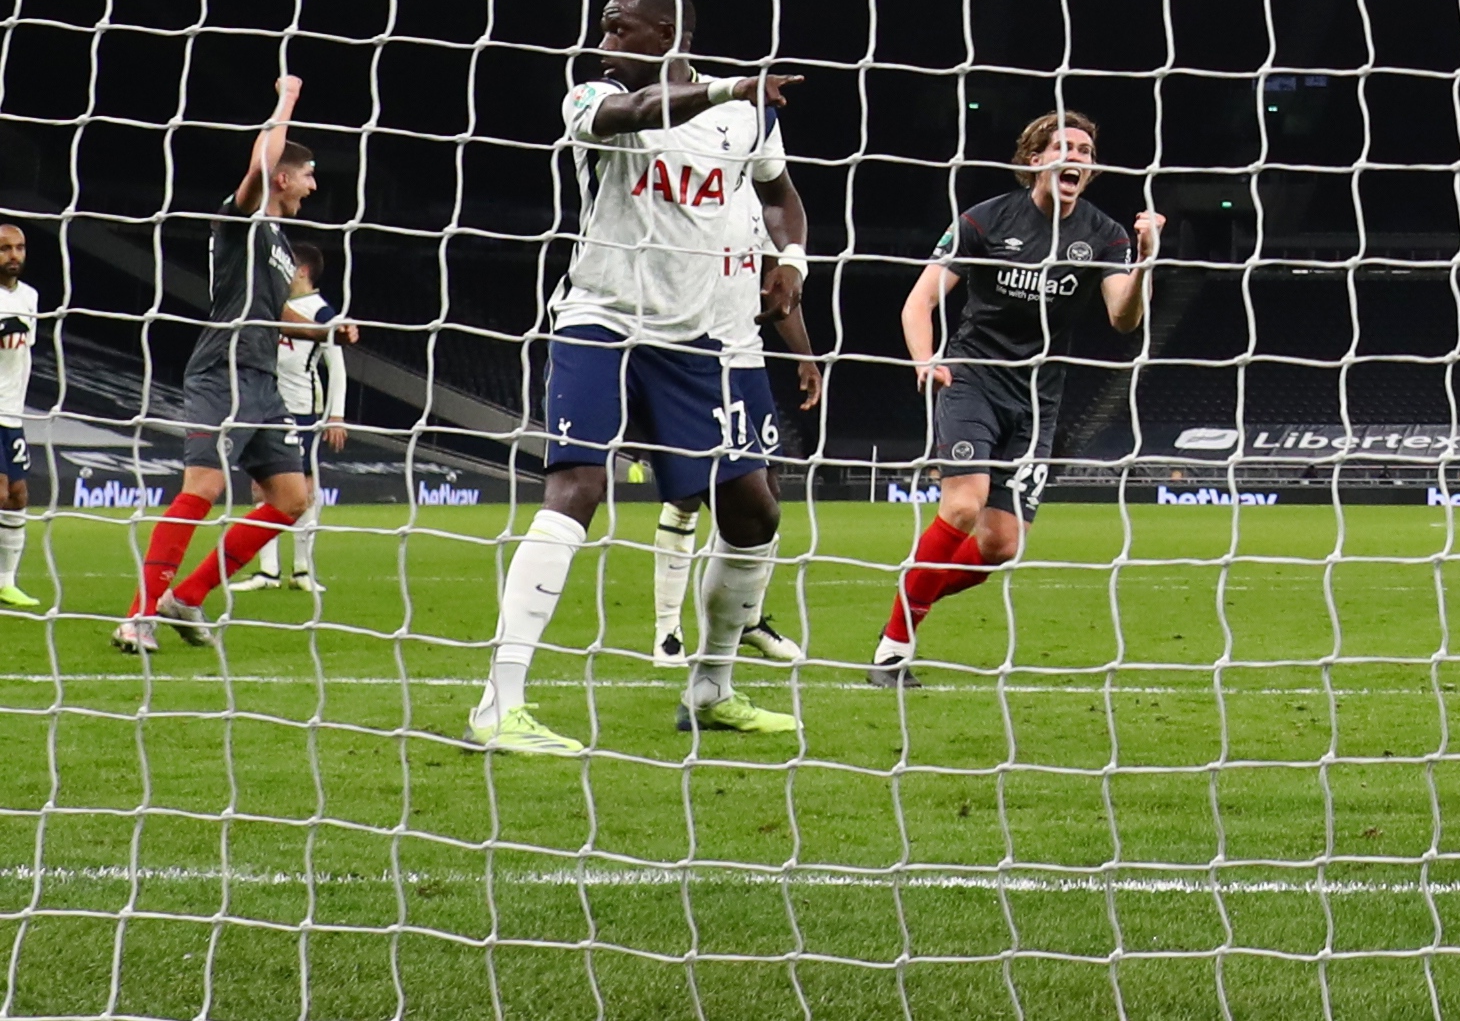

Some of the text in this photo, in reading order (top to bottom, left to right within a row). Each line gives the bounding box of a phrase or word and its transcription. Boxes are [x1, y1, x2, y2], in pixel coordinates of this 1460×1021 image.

[631, 159, 725, 207] AIA
[712, 400, 747, 448] 17
[761, 413, 779, 446] 6
[1252, 431, 1460, 450] Libertex
[1157, 486, 1278, 505] betway
